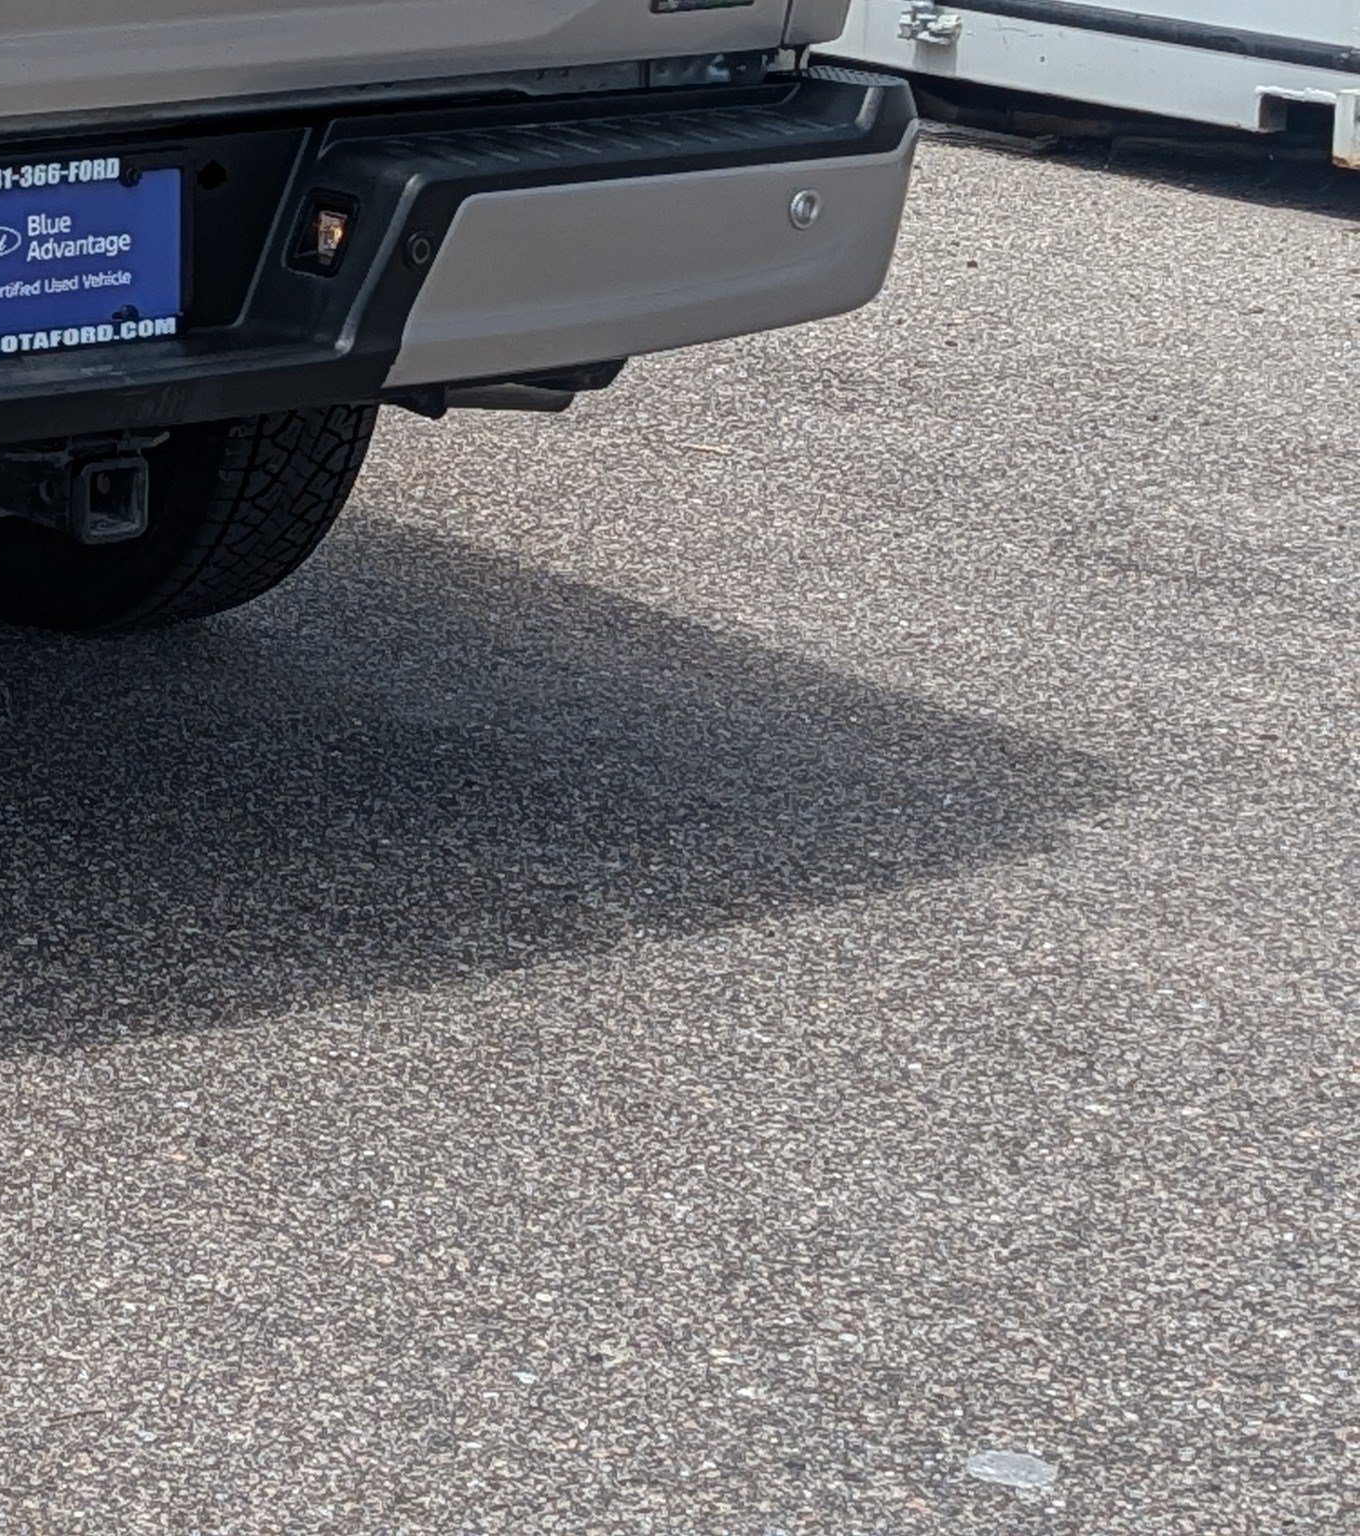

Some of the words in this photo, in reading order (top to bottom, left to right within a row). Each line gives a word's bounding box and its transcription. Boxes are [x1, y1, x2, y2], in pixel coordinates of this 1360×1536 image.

[27, 214, 71, 236] Blue
[26, 233, 131, 262] Advantage
[44, 276, 79, 293] Used
[82, 270, 131, 290] Vehicle
